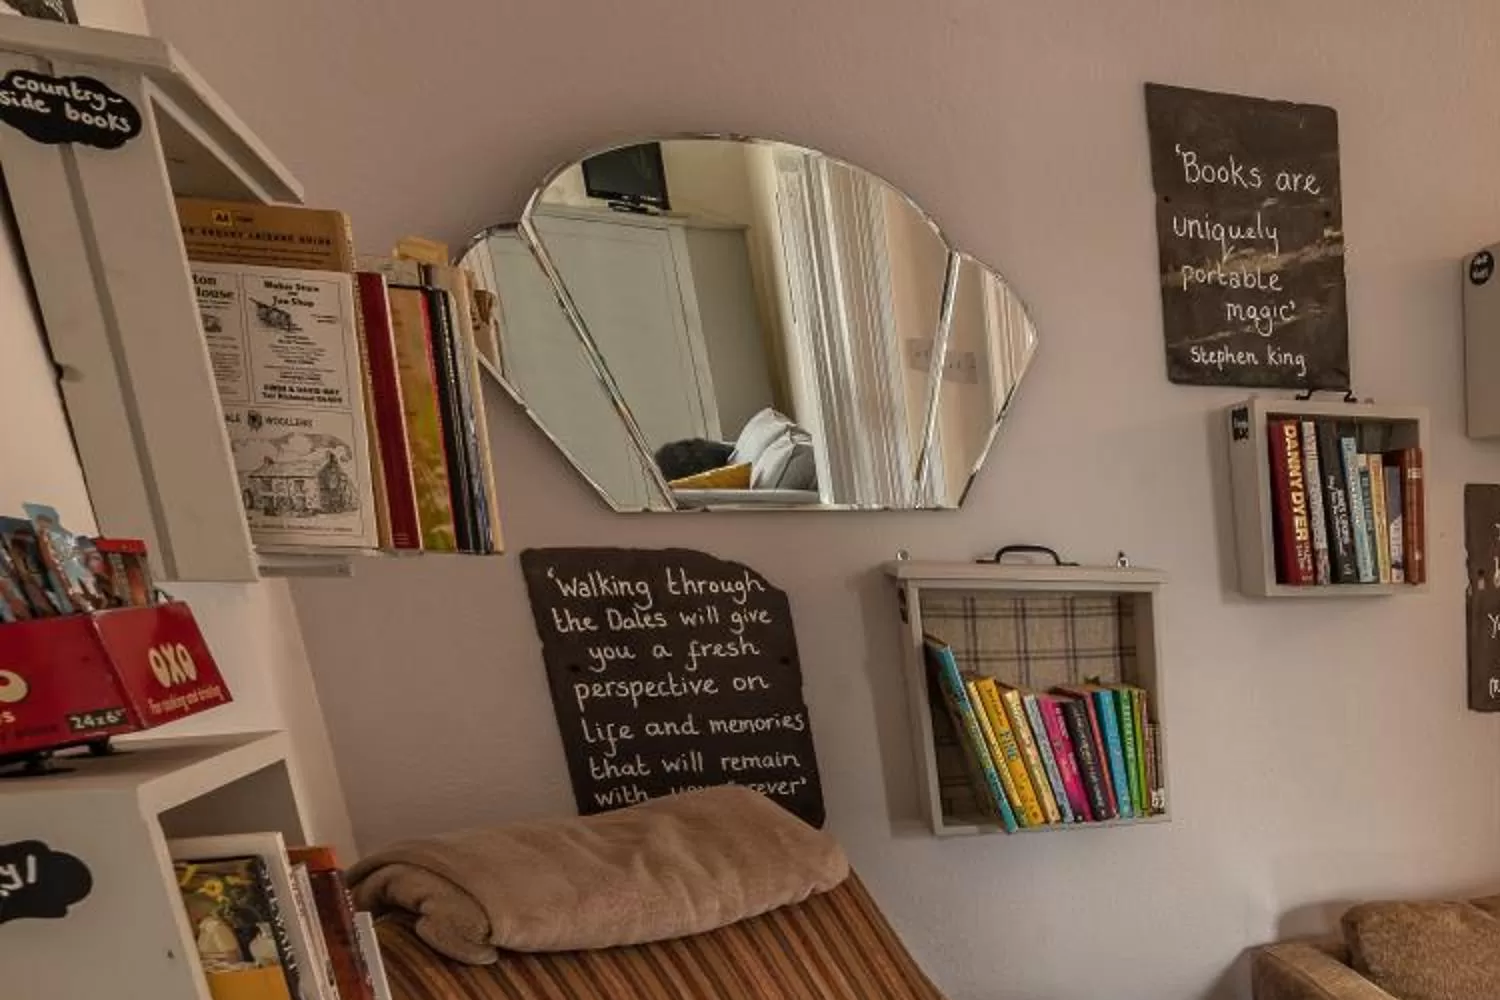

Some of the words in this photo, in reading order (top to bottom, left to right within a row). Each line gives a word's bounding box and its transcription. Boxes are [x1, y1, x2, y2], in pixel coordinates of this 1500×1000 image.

[64, 102, 132, 133] books
[1275, 172, 1321, 195] are
[1181, 262, 1284, 293] portable
[1189, 344, 1259, 370] Stephen
[1283, 423, 1304, 488] DANNY
[1290, 490, 1308, 541] DYER
[666, 566, 766, 604] through
[552, 607, 598, 633] the
[607, 607, 668, 632] Dales
[680, 605, 720, 627] will
[730, 605, 773, 635] give
[148, 643, 198, 689] OXO
[588, 645, 637, 672] you
[653, 645, 672, 658] a
[685, 636, 761, 671] fresh
[574, 672, 719, 712] perspective
[732, 673, 770, 692] on
[581, 716, 635, 757] life
[645, 713, 700, 736] and
[709, 711, 805, 735] memories
[589, 754, 651, 781] that
[662, 751, 704, 773] will
[720, 752, 802, 771] remain
[595, 785, 648, 808] with
